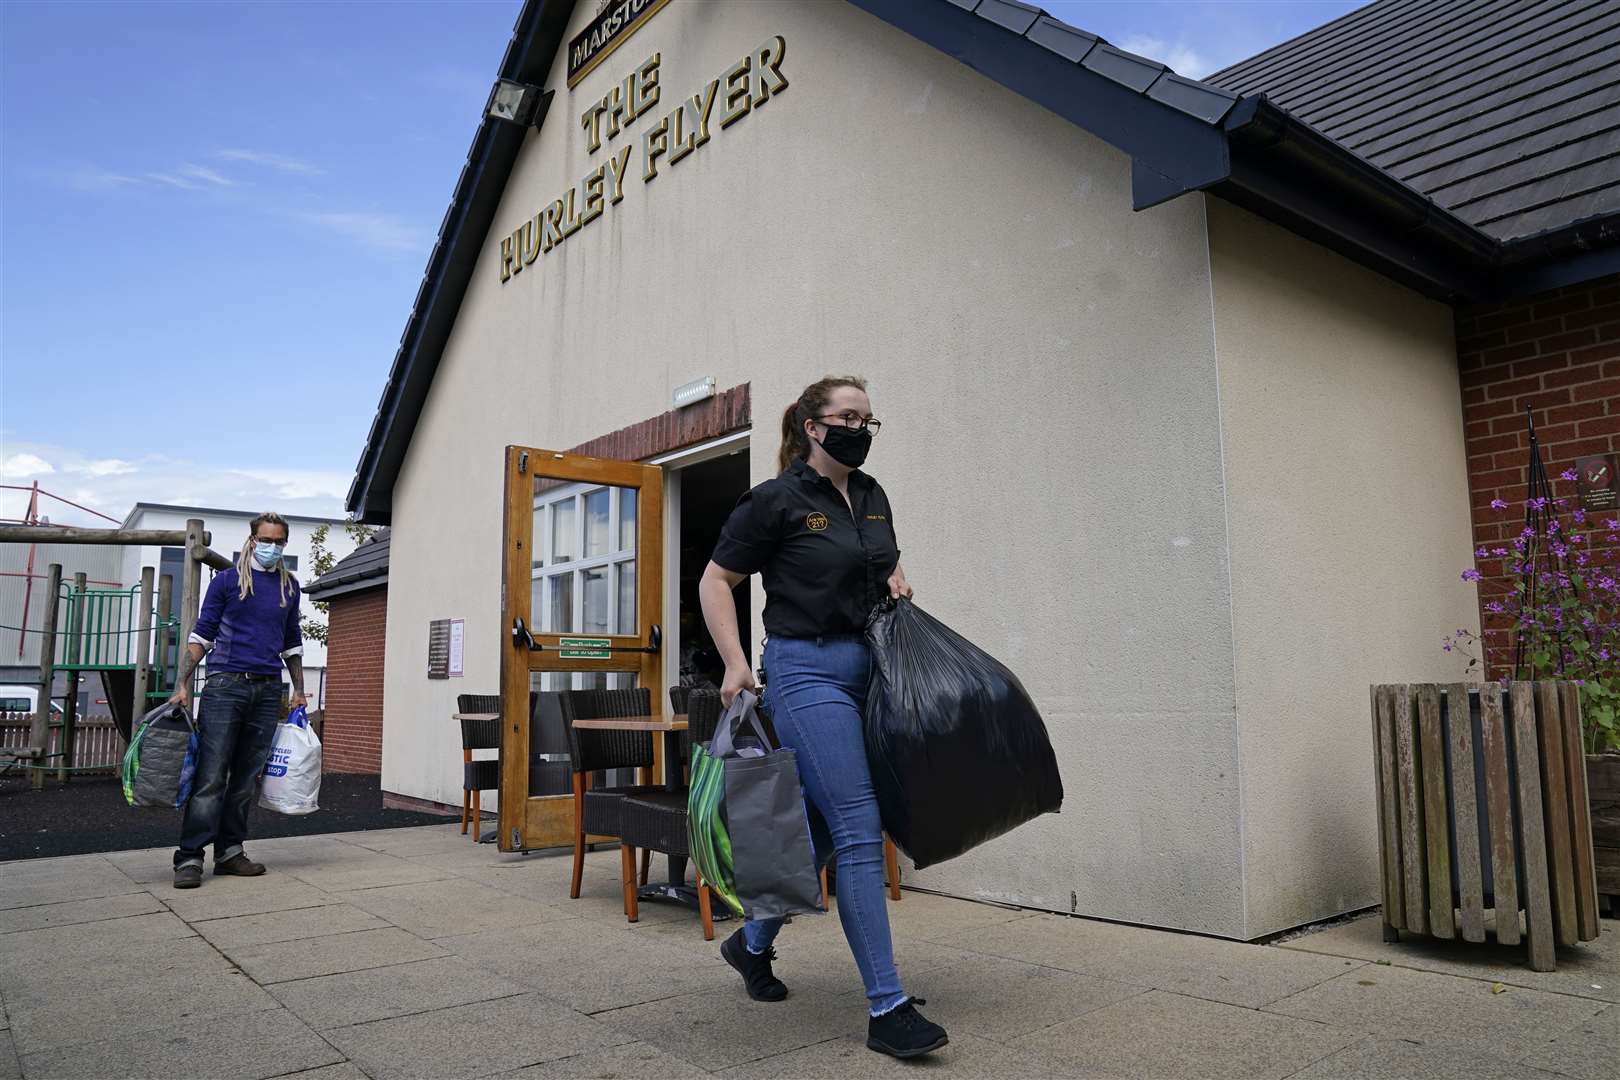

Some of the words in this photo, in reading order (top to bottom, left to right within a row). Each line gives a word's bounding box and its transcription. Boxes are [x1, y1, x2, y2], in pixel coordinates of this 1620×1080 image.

[572, 0, 651, 70] MARSTO
[581, 52, 661, 155] THE
[499, 144, 632, 284] HURLEY
[641, 35, 789, 184] FLYER
[266, 753, 290, 764] STIC
